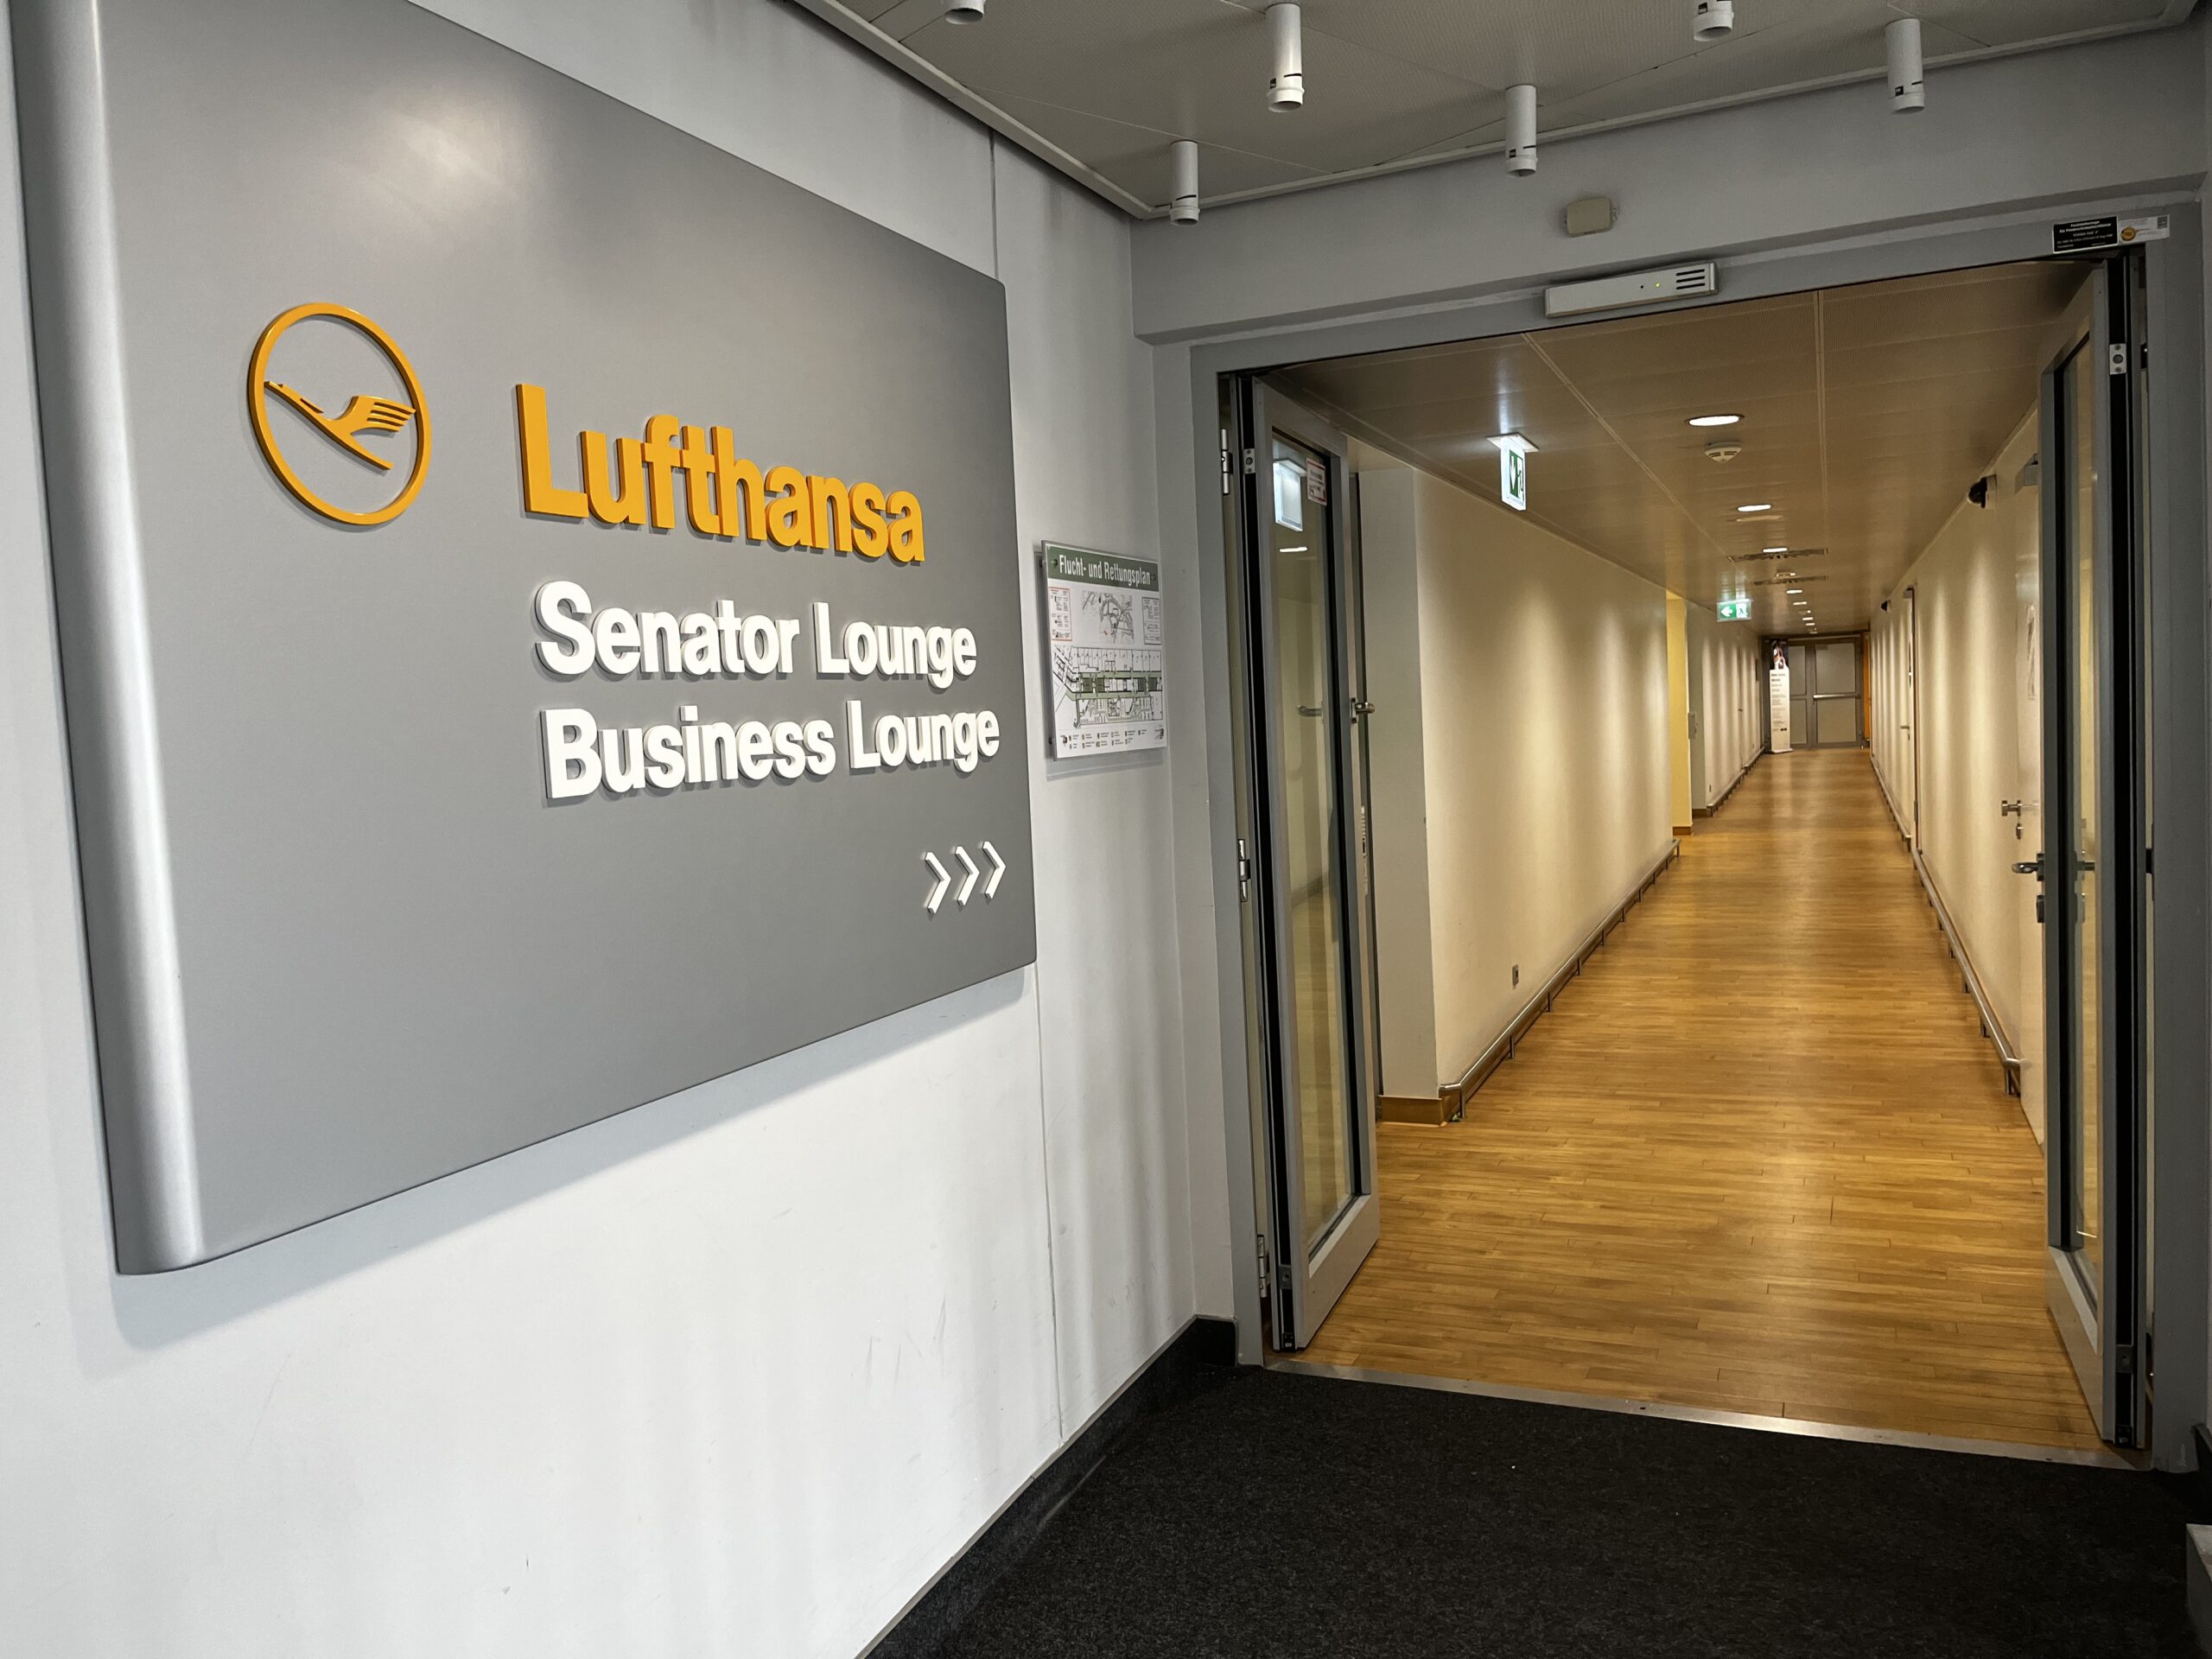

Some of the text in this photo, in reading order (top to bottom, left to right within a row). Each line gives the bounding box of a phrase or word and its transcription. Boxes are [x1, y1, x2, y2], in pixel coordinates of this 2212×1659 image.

[516, 383, 925, 563] Lufthansa
[1058, 554, 1151, 588] Flucht- und Rettungsplan
[535, 580, 799, 676] Senator
[813, 601, 977, 689] Lounge
[541, 700, 1001, 799] Business Lounge
